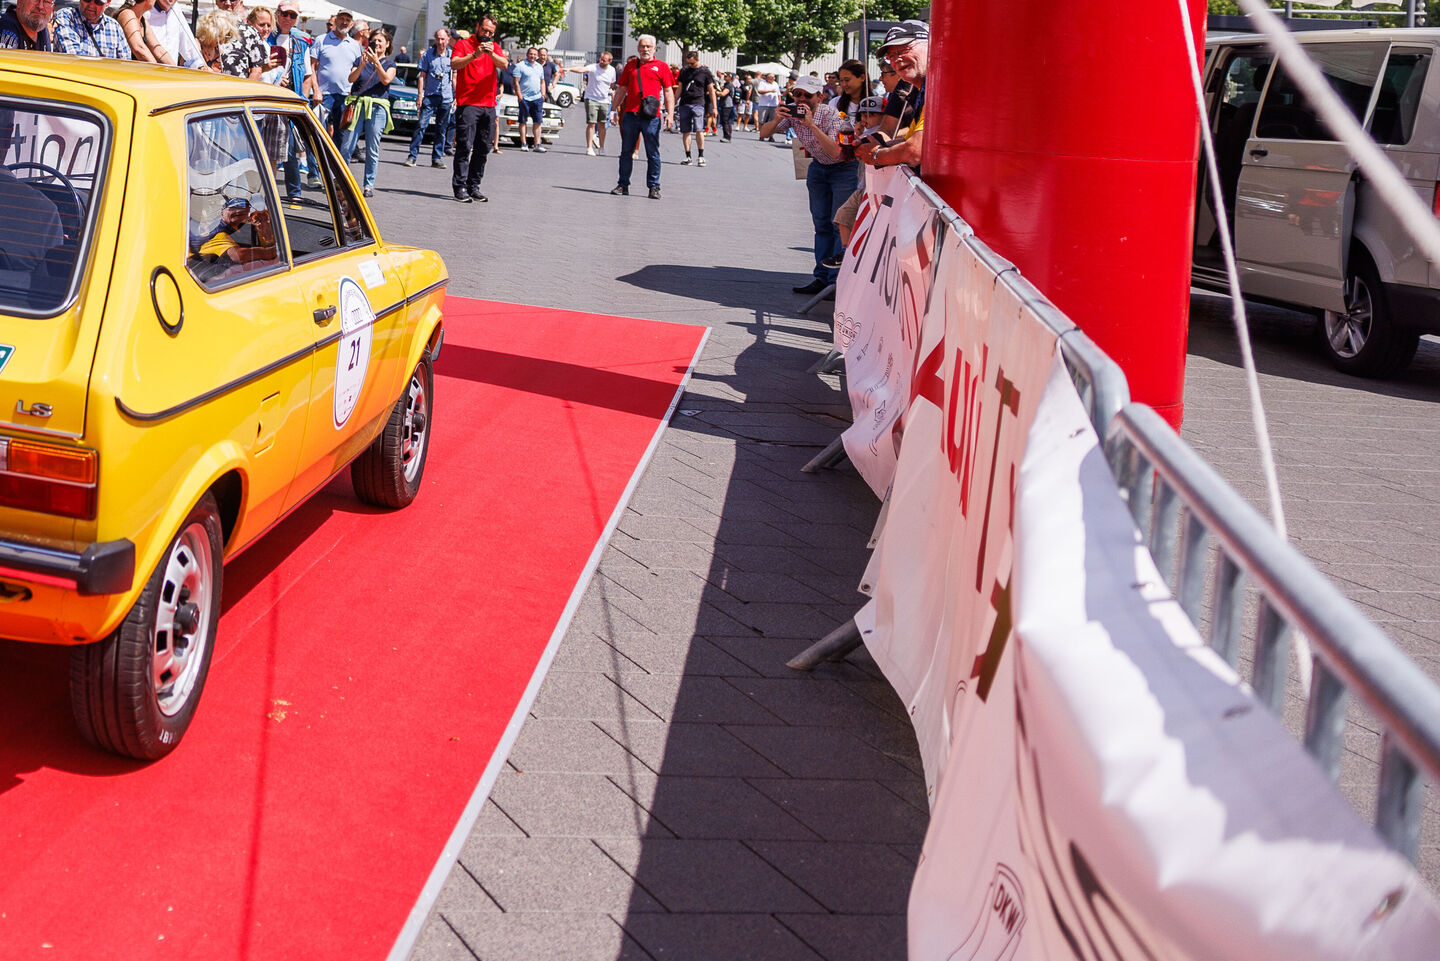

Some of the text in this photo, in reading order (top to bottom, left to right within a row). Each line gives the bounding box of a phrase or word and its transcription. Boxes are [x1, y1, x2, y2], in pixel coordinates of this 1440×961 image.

[347, 336, 361, 372] 21
[16, 399, 53, 418] LS
[993, 883, 1021, 936] DKW
